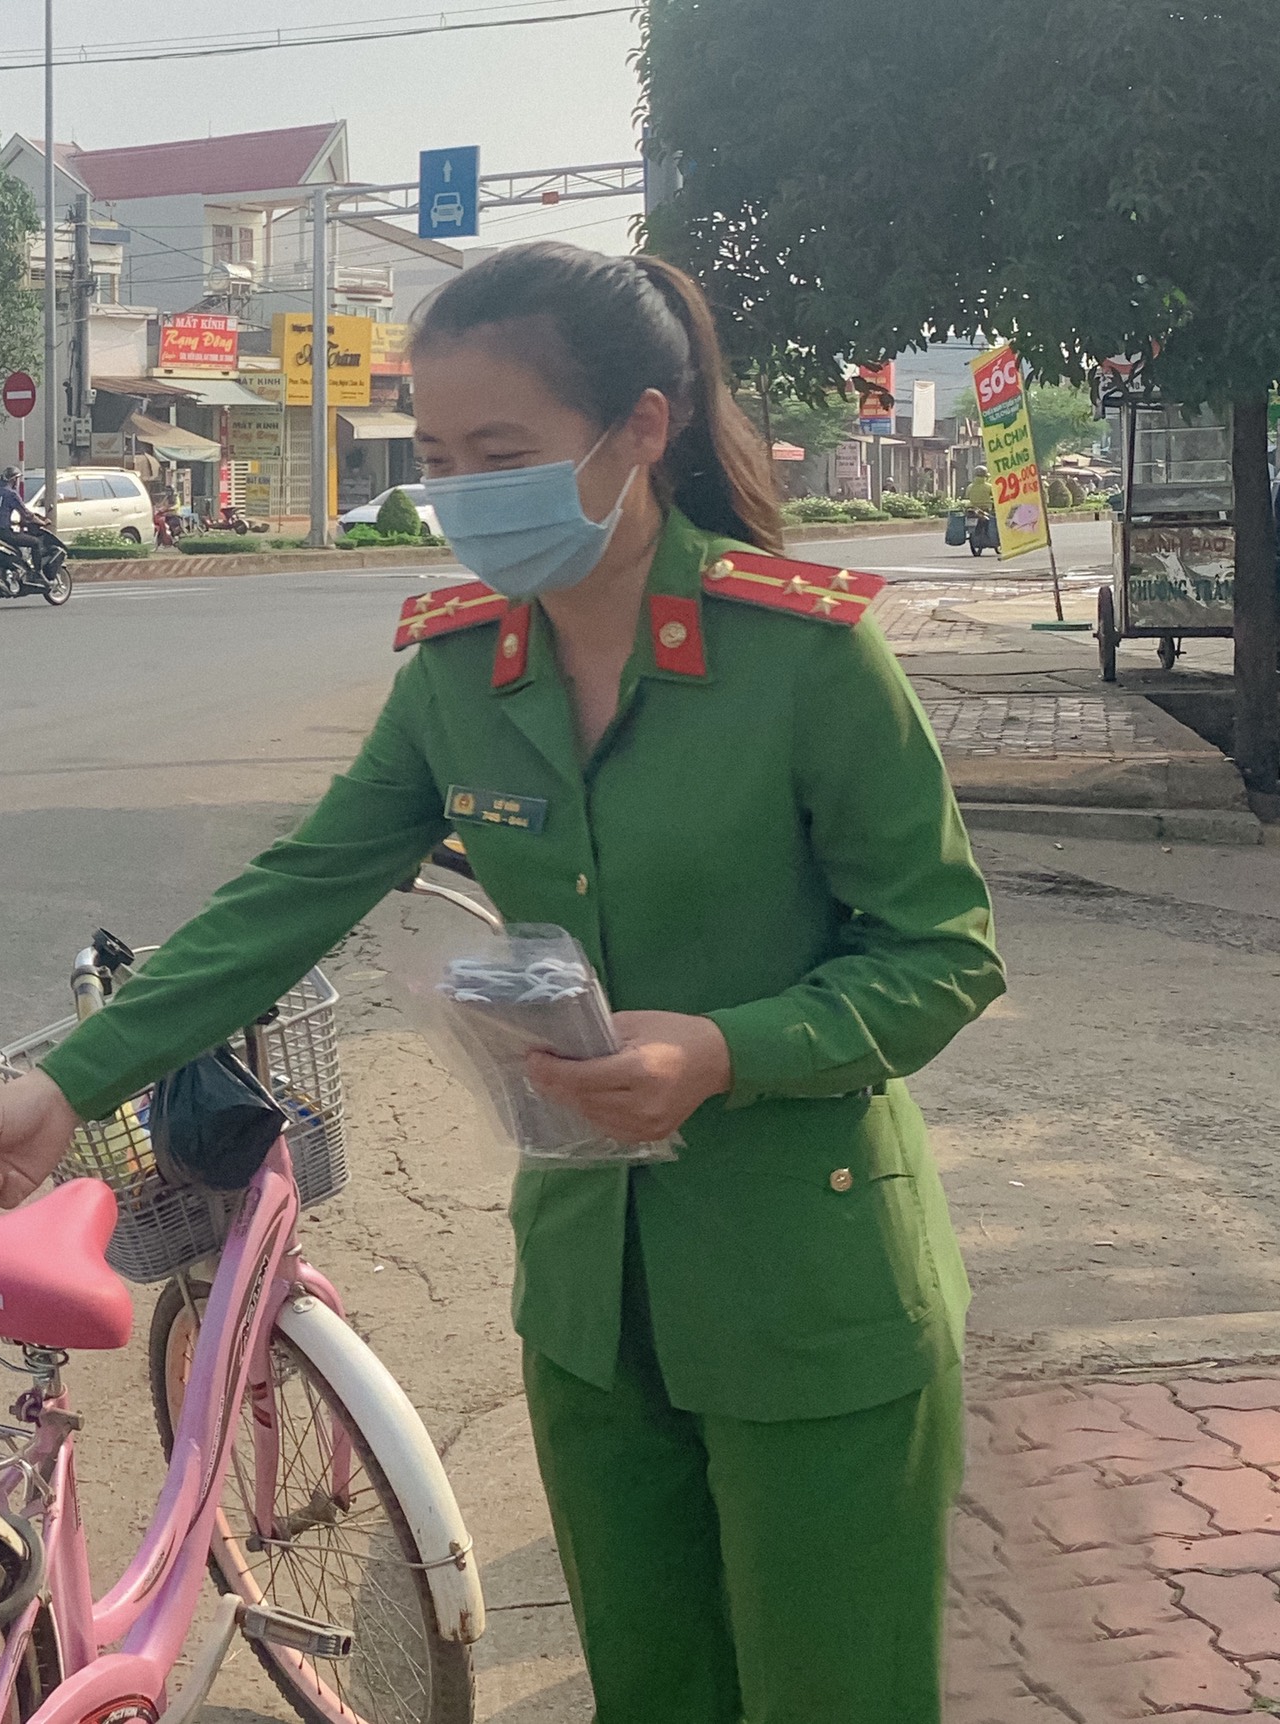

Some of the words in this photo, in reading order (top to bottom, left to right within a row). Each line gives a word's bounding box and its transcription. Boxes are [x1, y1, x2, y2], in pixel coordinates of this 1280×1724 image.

[175, 316, 198, 328] MẮT
[200, 317, 226, 330] KÍNH
[164, 329, 200, 351] Rạng
[202, 331, 233, 352] Đông
[979, 358, 1017, 403] SỐC
[988, 434, 1003, 453] CÁ
[1004, 424, 1028, 447] CHIM
[994, 446, 1030, 473] TRẮNG
